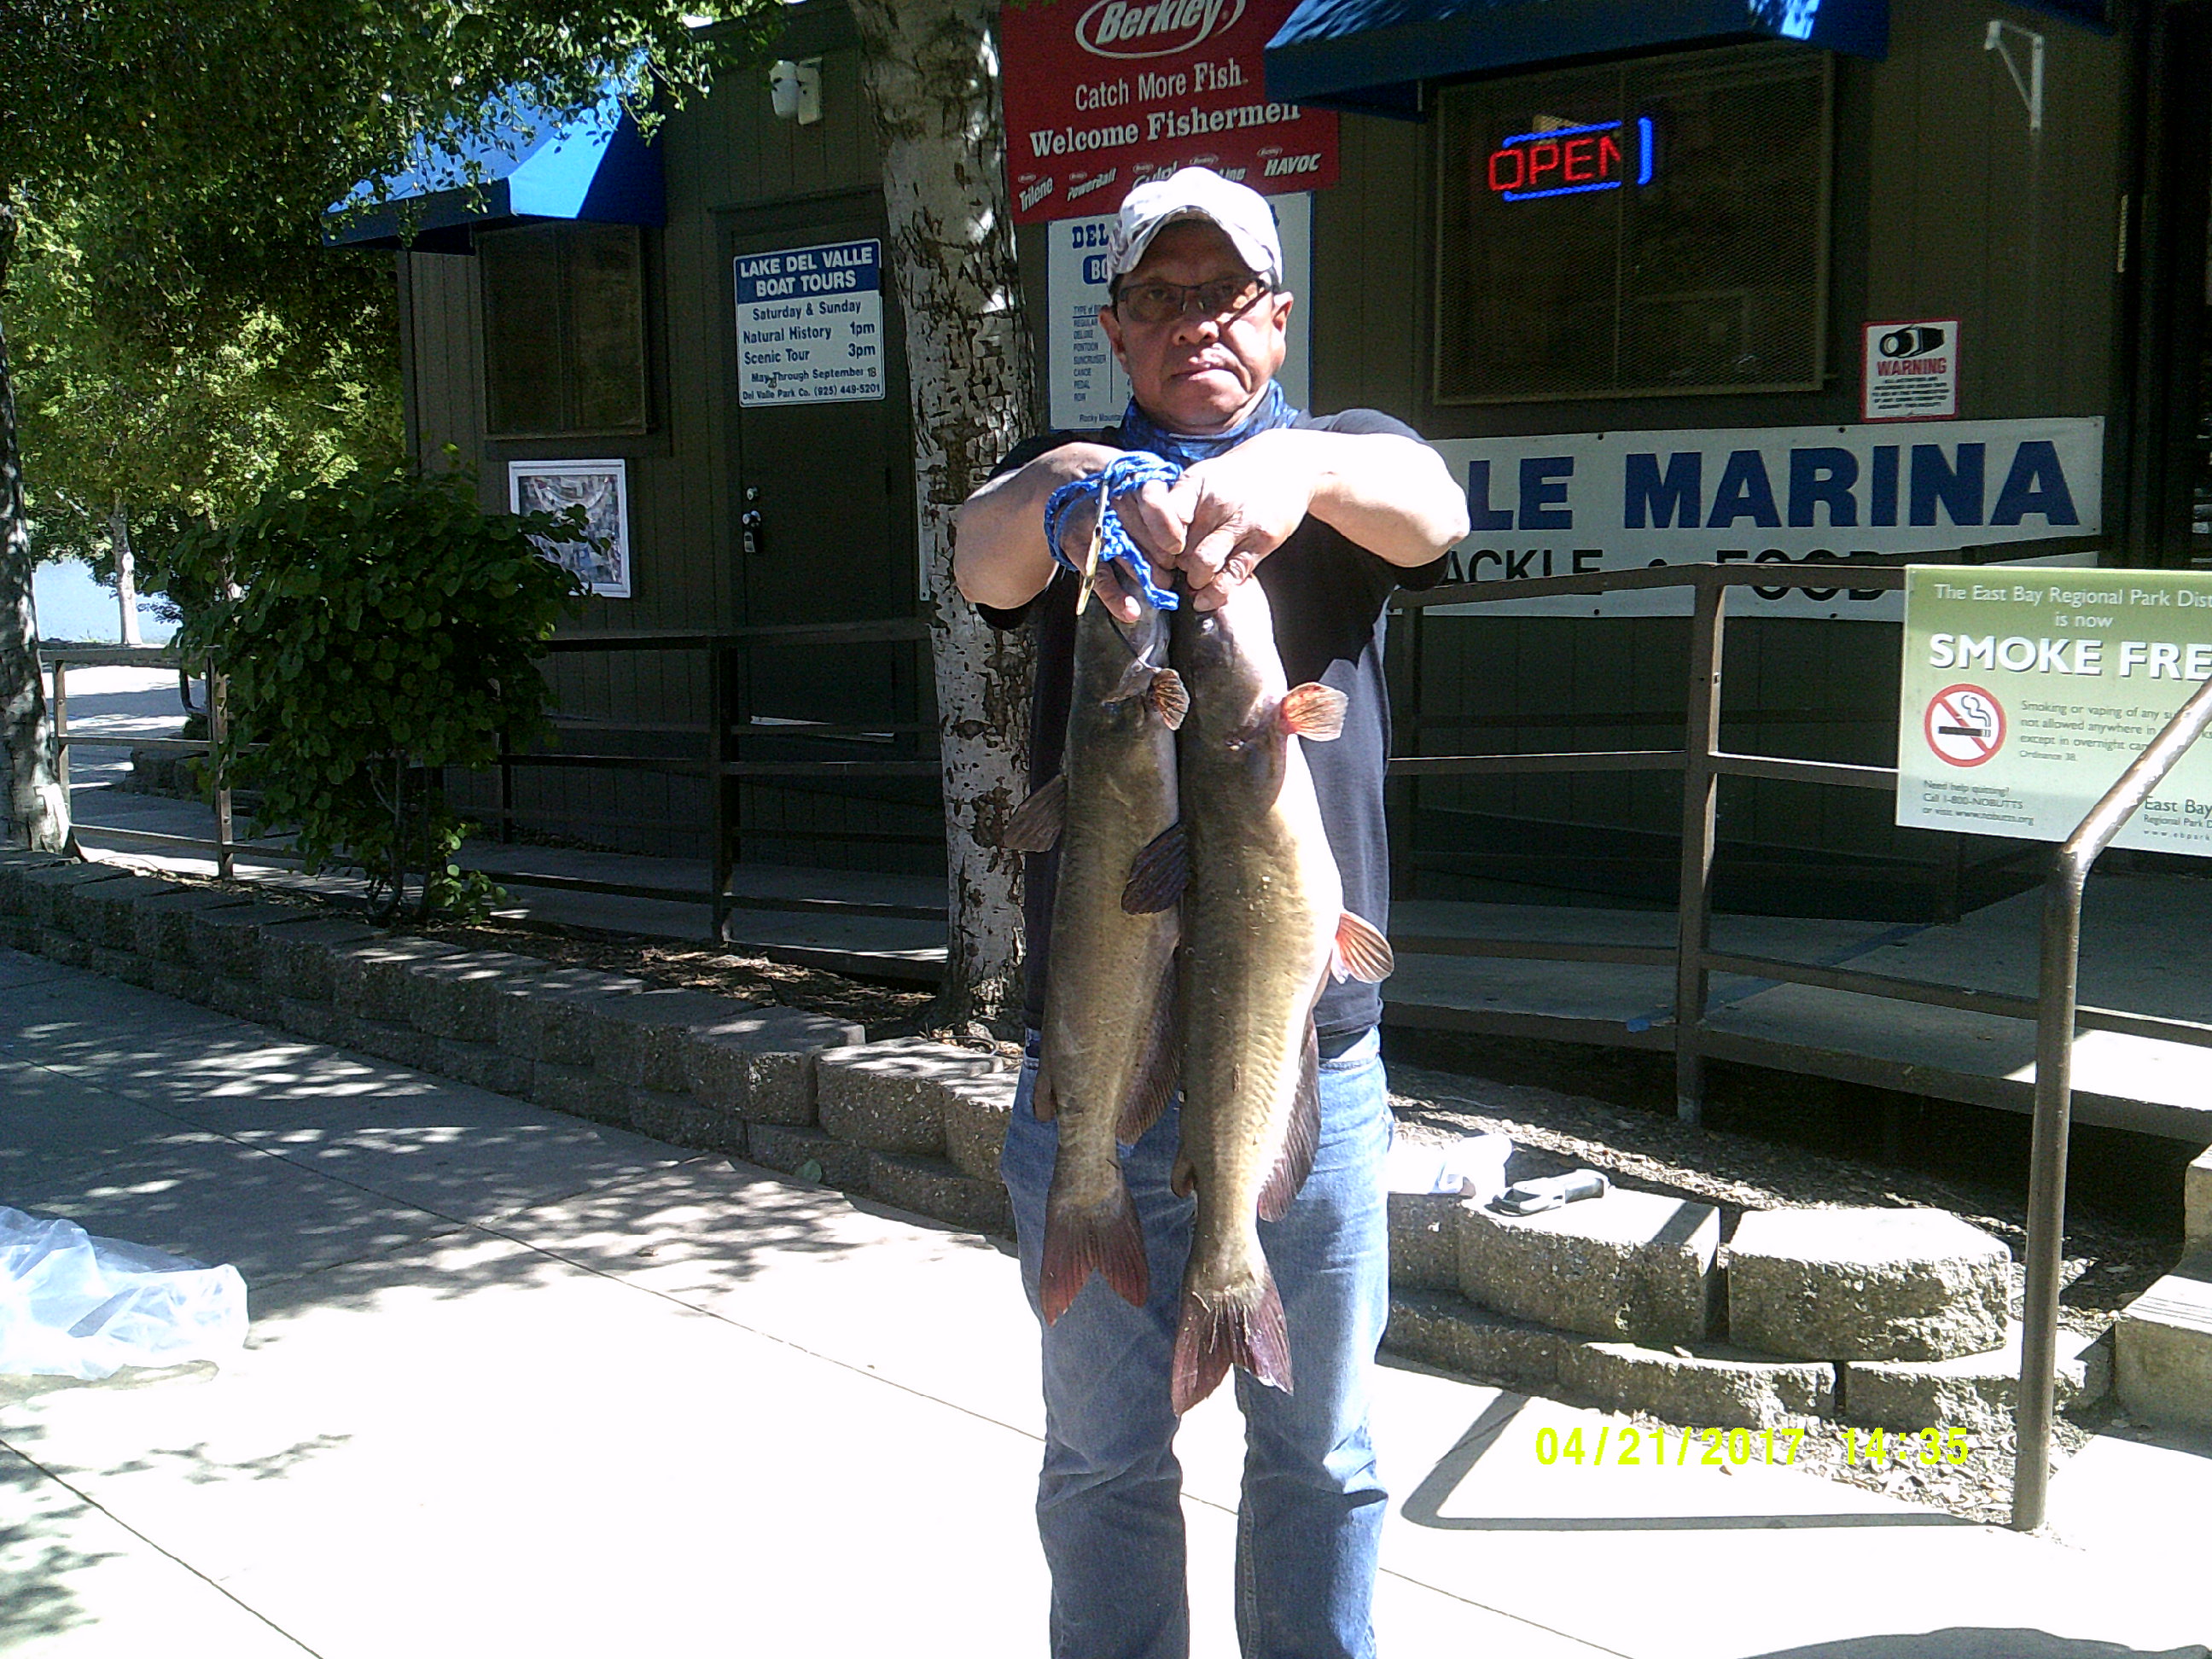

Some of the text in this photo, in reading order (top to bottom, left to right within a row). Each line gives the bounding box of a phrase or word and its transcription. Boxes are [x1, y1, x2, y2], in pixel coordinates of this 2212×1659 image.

[1096, 0, 1224, 44] Berkley
[1075, 79, 1129, 111] Catch
[1138, 72, 1186, 102] More
[1030, 102, 1301, 158] Welcome Fishermen
[1264, 153, 1322, 178] HAVOC
[1488, 136, 1621, 191] OPEN
[1019, 177, 1053, 212] Trilene
[1073, 224, 1109, 248] DEL
[741, 247, 873, 278] LAKE DEL VALLE
[756, 271, 857, 297] BOAT TOURS
[753, 300, 861, 321] Saturday & Sunday
[743, 321, 875, 344] Natural History 1pm
[744, 343, 876, 365] Scenic Tour 3pm
[772, 370, 809, 382] Through
[812, 367, 863, 380] September
[1877, 358, 1947, 376] WARNING
[742, 390, 754, 400] Del
[757, 389, 775, 399] Valle
[777, 387, 795, 399] Park
[1469, 440, 2080, 532] LE MARINA
[1934, 584, 1966, 600] The
[1972, 585, 2006, 601] East
[2013, 585, 2043, 606] Bay
[2049, 587, 2123, 608] Regional
[2129, 590, 2169, 607] Park
[2055, 611, 2114, 628] is now
[1930, 633, 2103, 677] SMOKE
[2021, 700, 2067, 715] Smoking
[2088, 705, 2122, 719] vaping
[2126, 707, 2138, 717] of
[2141, 710, 2159, 720] any
[2020, 718, 2156, 735] not allowed anywhere in
[2020, 735, 2055, 747] except
[2059, 735, 2069, 745] in
[2074, 737, 2124, 751] overnight
[1924, 779, 1947, 790] Need
[1924, 793, 1940, 802] Call
[2145, 795, 2212, 819] East Bay
[2144, 814, 2180, 826] Regional
[2184, 818, 2203, 827] Park
